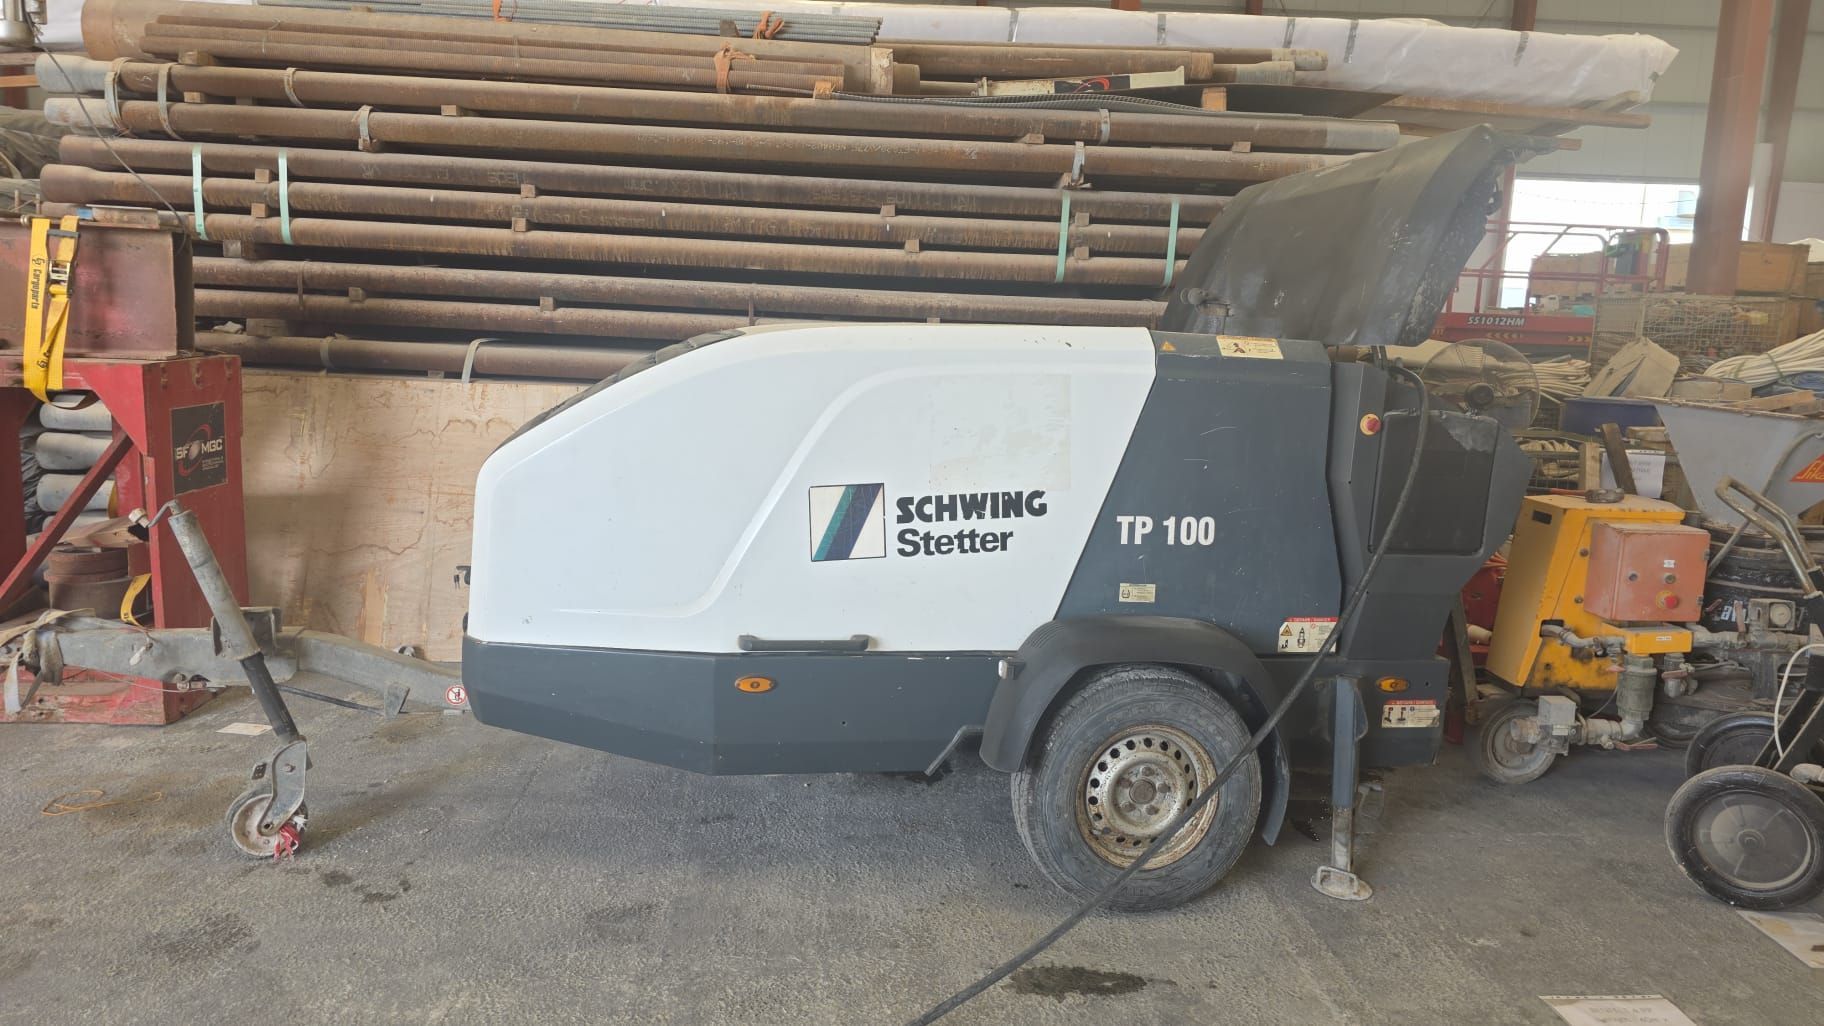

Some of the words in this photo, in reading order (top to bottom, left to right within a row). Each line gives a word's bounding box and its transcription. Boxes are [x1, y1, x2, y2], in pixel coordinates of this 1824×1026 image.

[201, 439, 224, 455] MGC
[896, 490, 1048, 525] SCHWING
[896, 528, 1014, 558] Stetter
[1116, 515, 1154, 545] TP
[1162, 515, 1216, 546] 100
